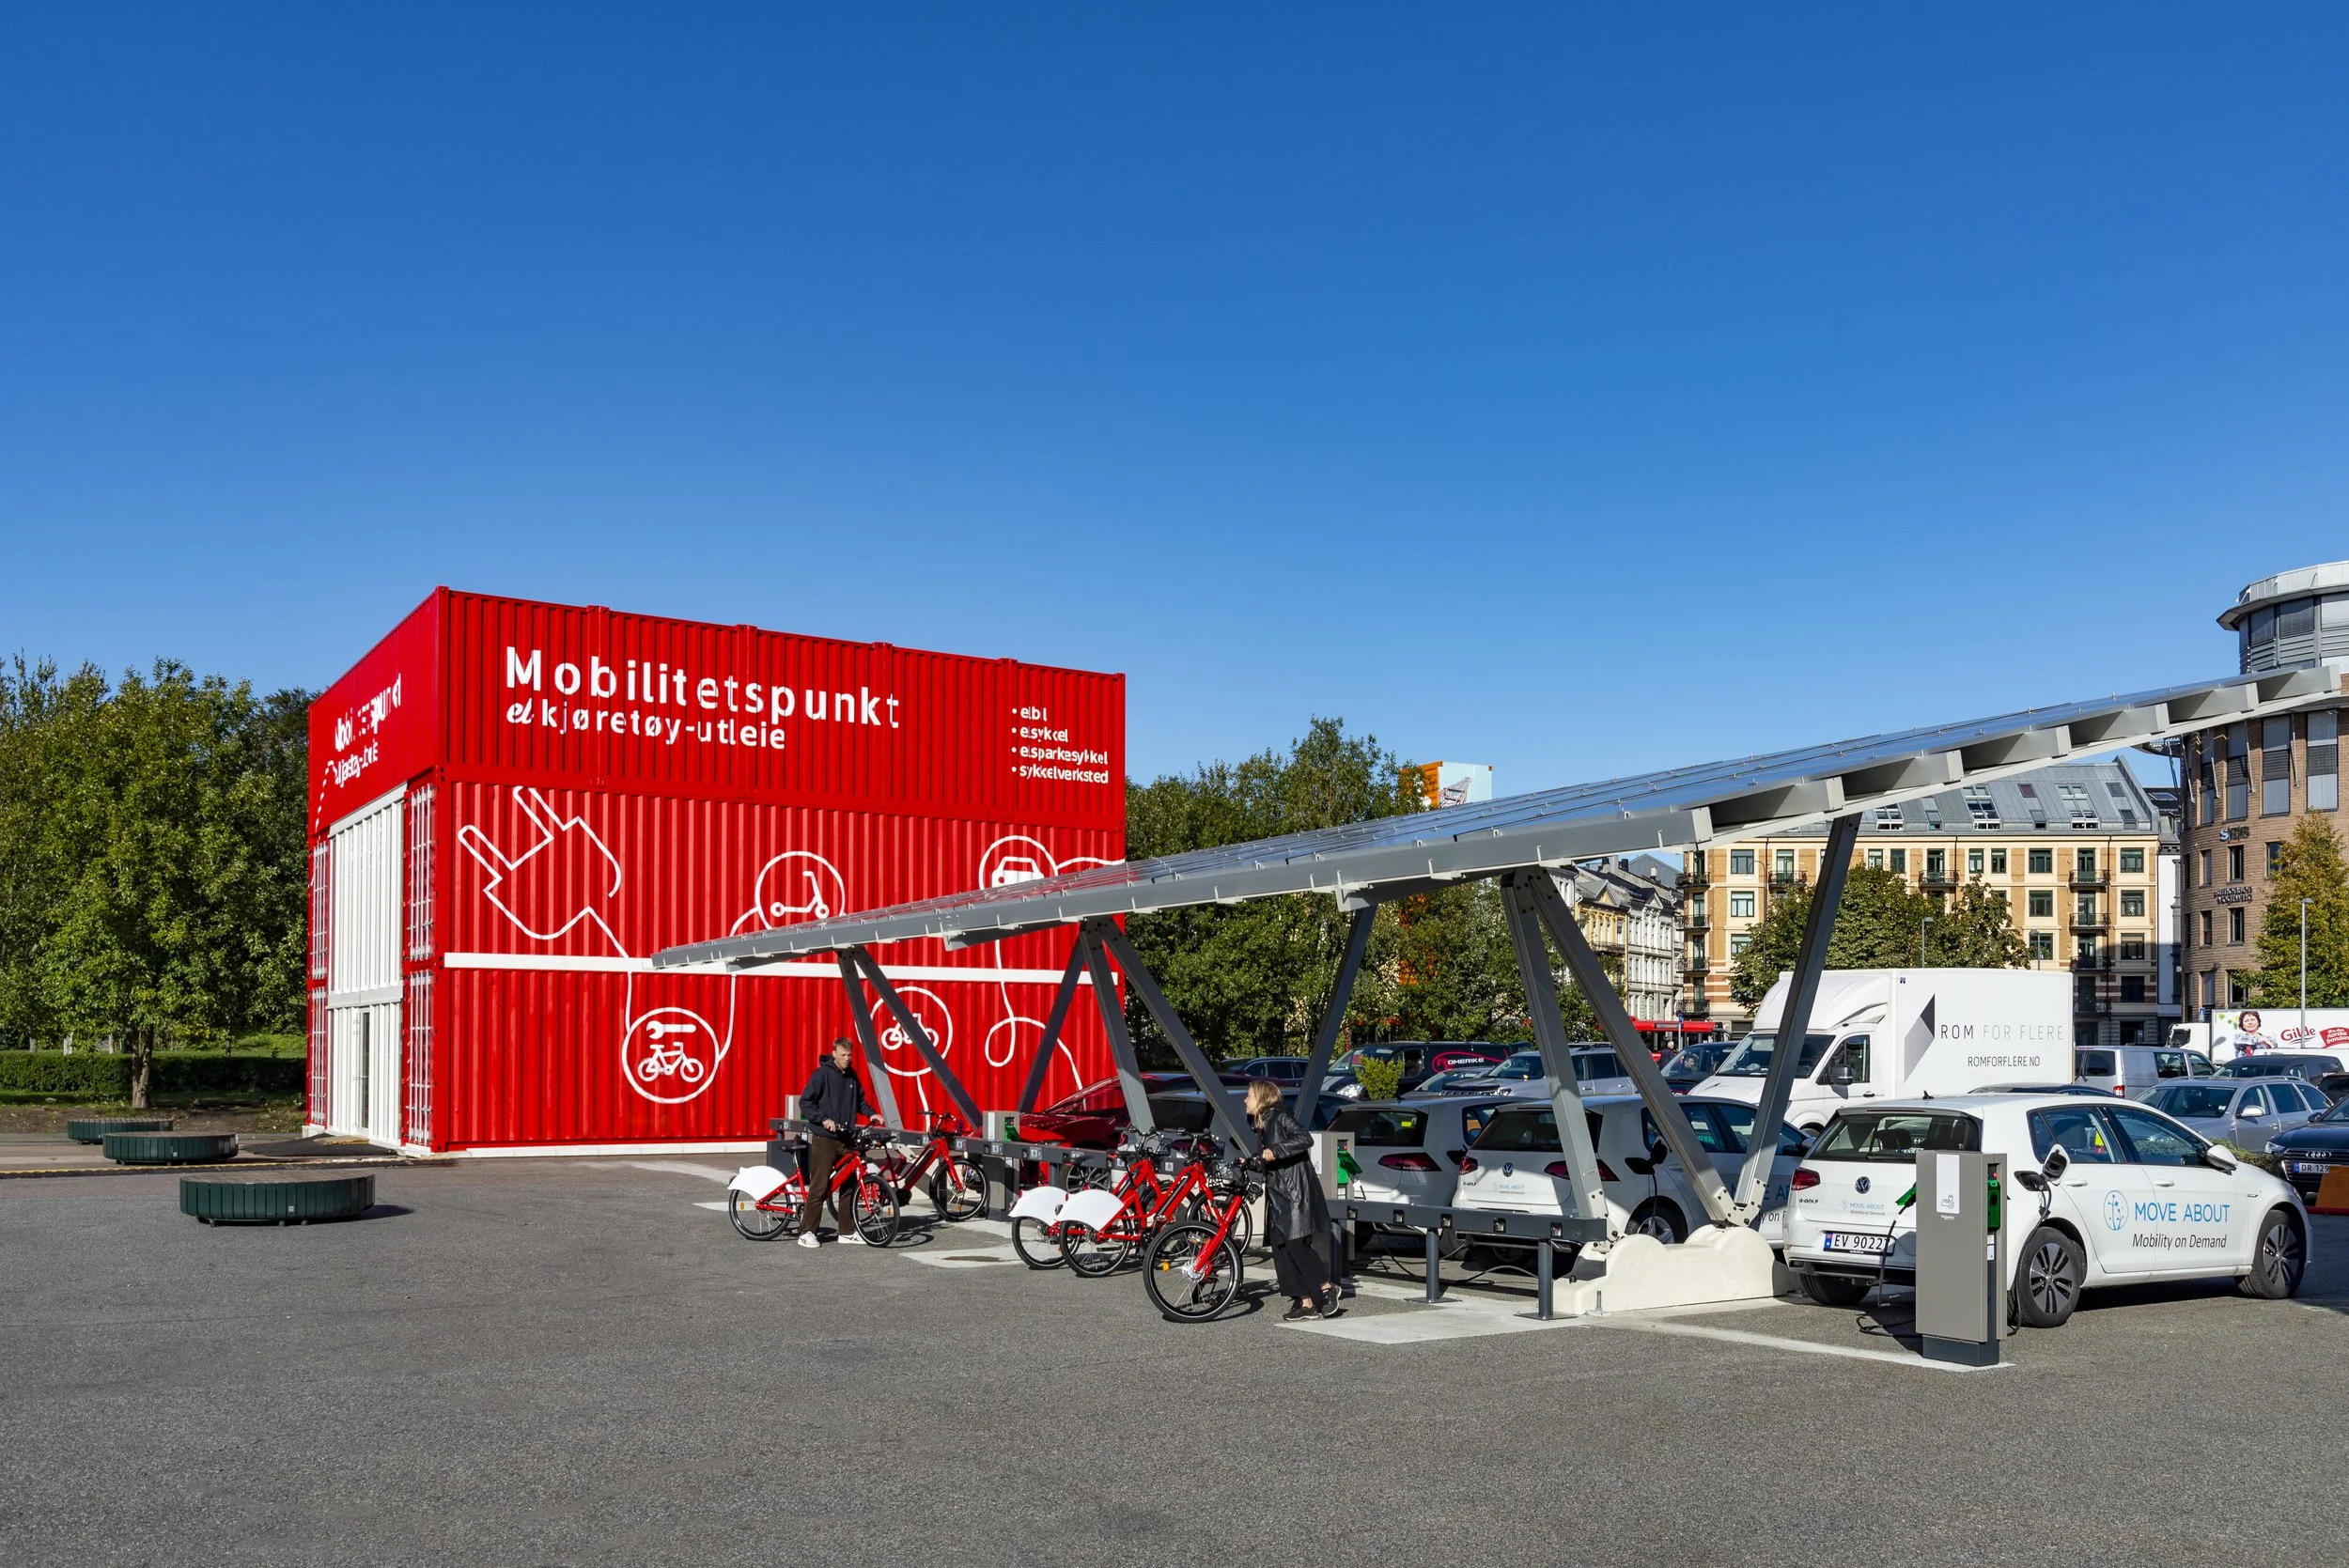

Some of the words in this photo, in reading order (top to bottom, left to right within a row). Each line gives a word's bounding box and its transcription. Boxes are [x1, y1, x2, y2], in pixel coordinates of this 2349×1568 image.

[506, 646, 899, 729] Mobilitetspunkt
[506, 698, 534, 724] el
[542, 699, 786, 749] kjøretøy-utleie
[1940, 1024, 1974, 1039] ROM
[1983, 1024, 2011, 1040] FOR
[2020, 1025, 2063, 1040] FLERE
[1968, 1056, 2041, 1067] ROMFORFLERE.NO
[2135, 1202, 2176, 1221] MOVE
[2184, 1203, 2230, 1222] ABOUT
[1834, 1234, 1849, 1248] EV
[1853, 1235, 1889, 1250] 9022
[2132, 1234, 2173, 1251] Mobility
[2174, 1237, 2186, 1248] on
[2189, 1234, 2227, 1248] Demand
